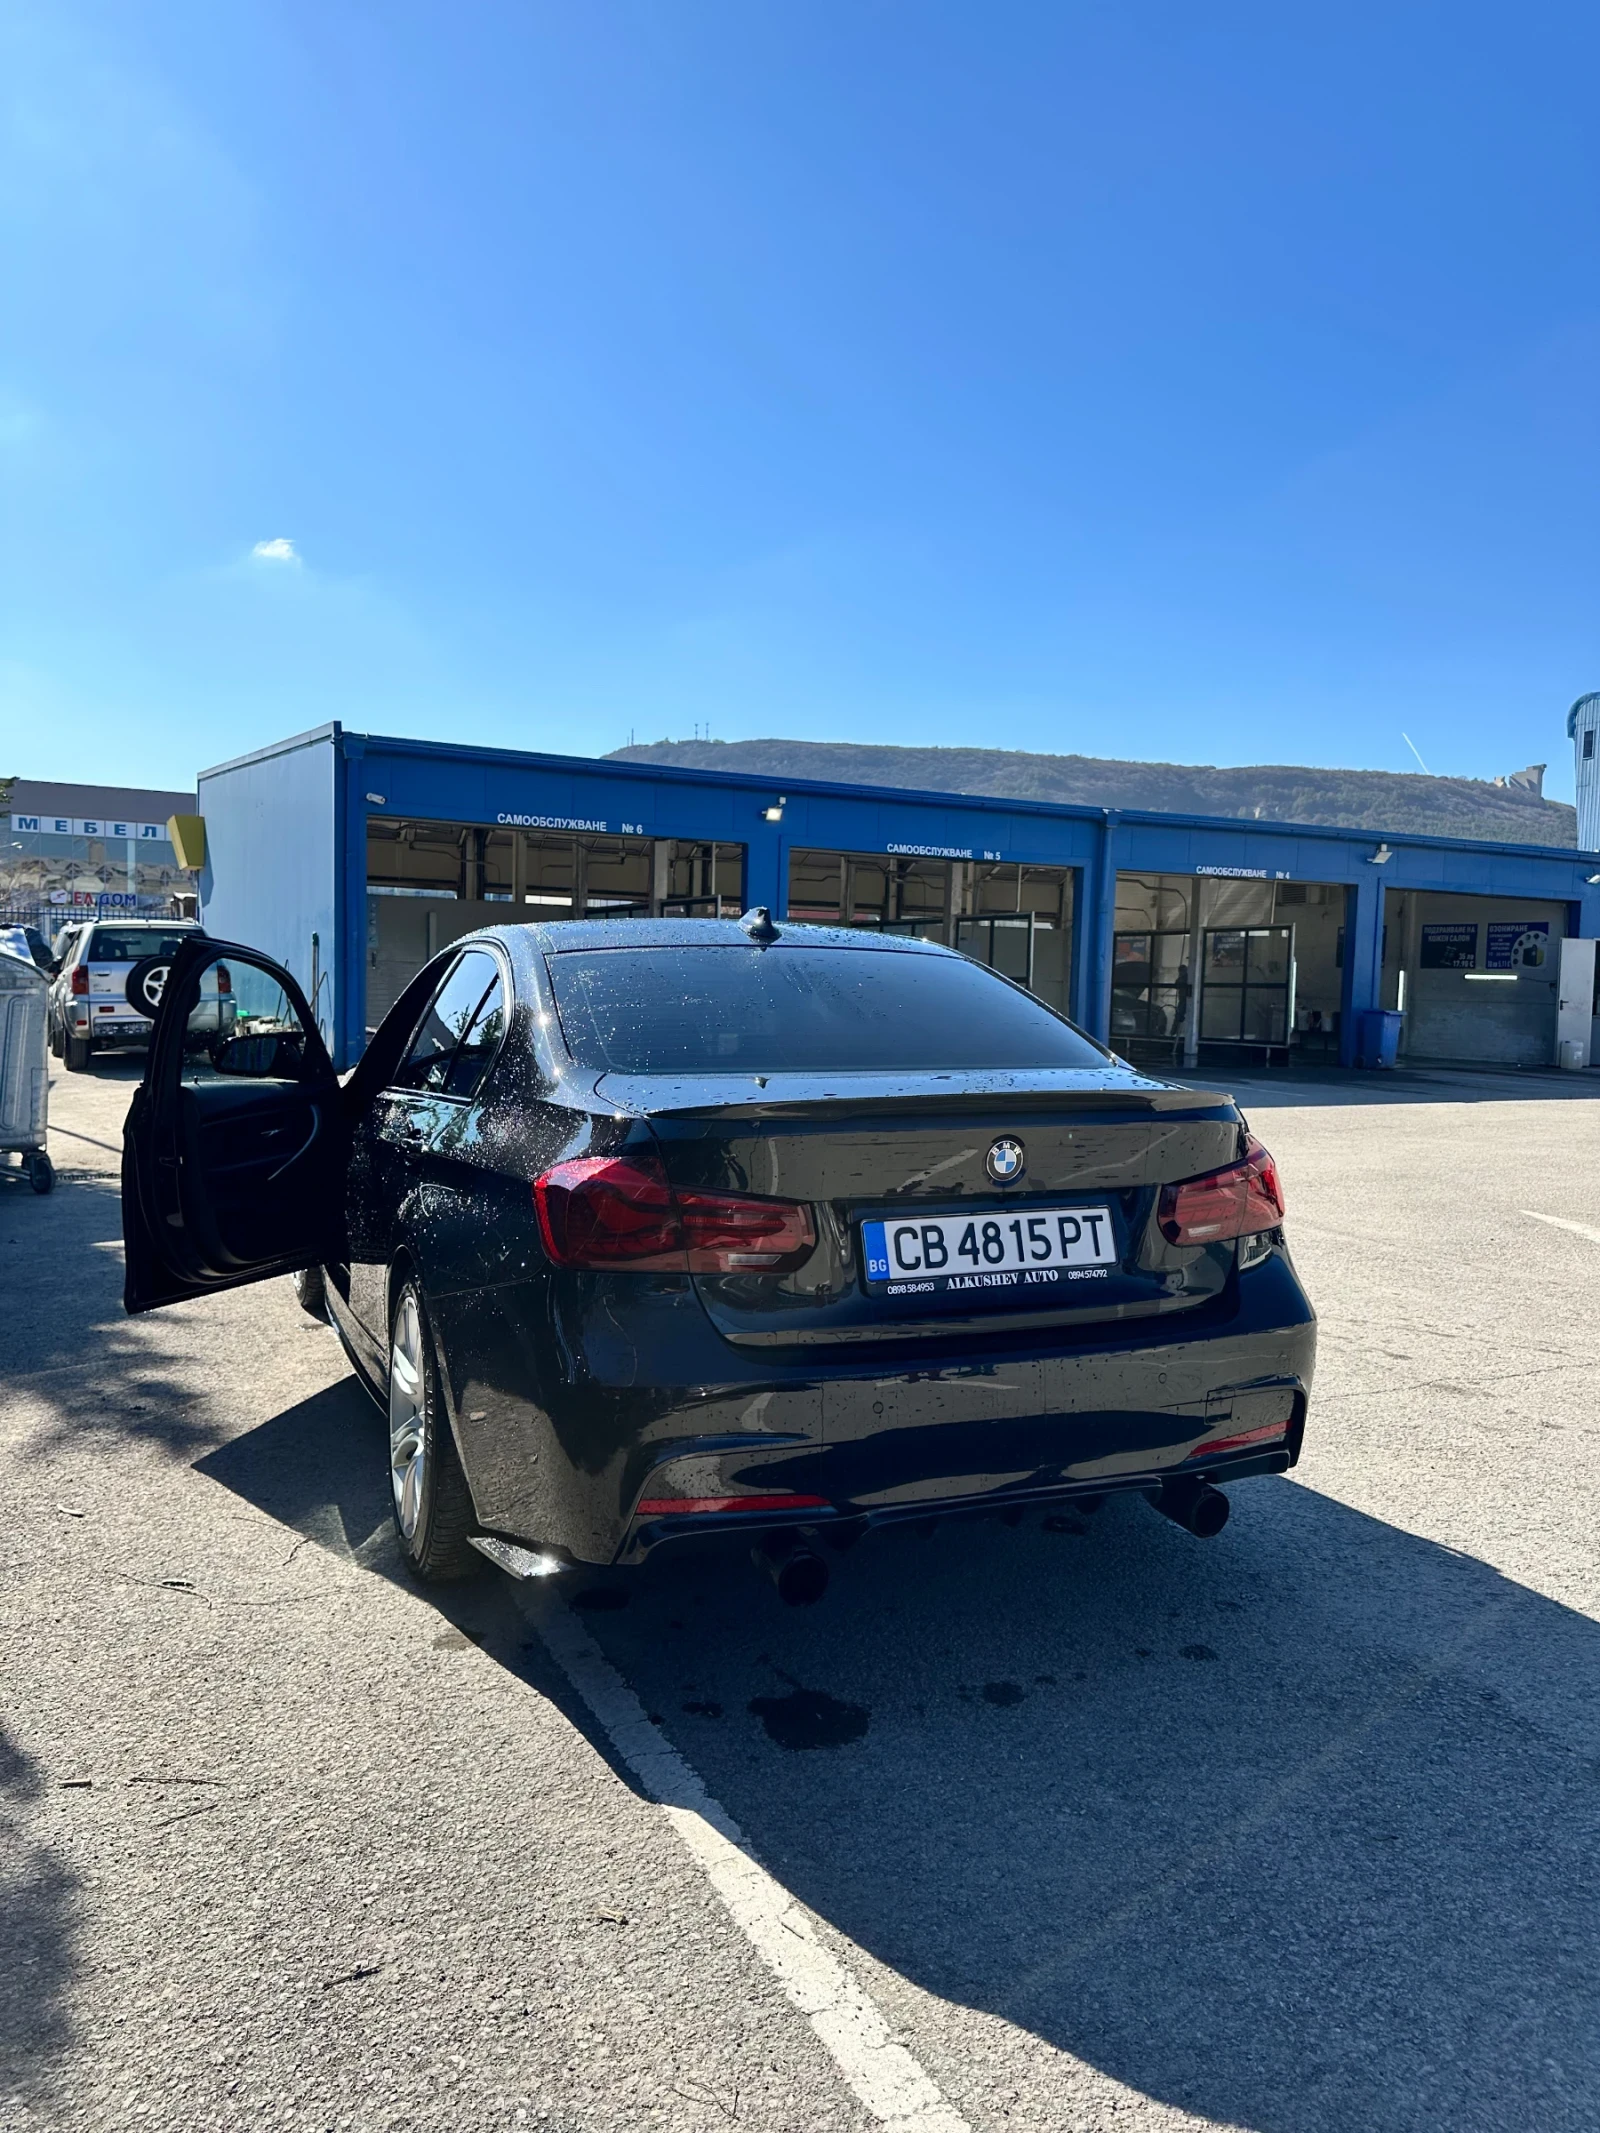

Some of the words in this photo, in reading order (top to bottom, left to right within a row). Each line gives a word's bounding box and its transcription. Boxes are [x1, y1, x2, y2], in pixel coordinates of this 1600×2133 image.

[497, 813, 607, 832] САМООБСЛУЖВАНЕ
[636, 824, 643, 835] 6
[886, 843, 973, 858] САМООБСЛУЖВАНЕ
[995, 851, 1001, 860] 5
[1196, 865, 1267, 878] САМООБСЛУЖВАНЕ
[1285, 871, 1290, 880] 4
[991, 1142, 1021, 1155] BMW
[893, 1224, 948, 1271] CB
[957, 1217, 1051, 1266] 4815
[1057, 1214, 1103, 1260] PT
[869, 1259, 887, 1273] BG
[946, 1272, 1019, 1291] ALKUSHEV
[1023, 1269, 1059, 1284] AUTO
